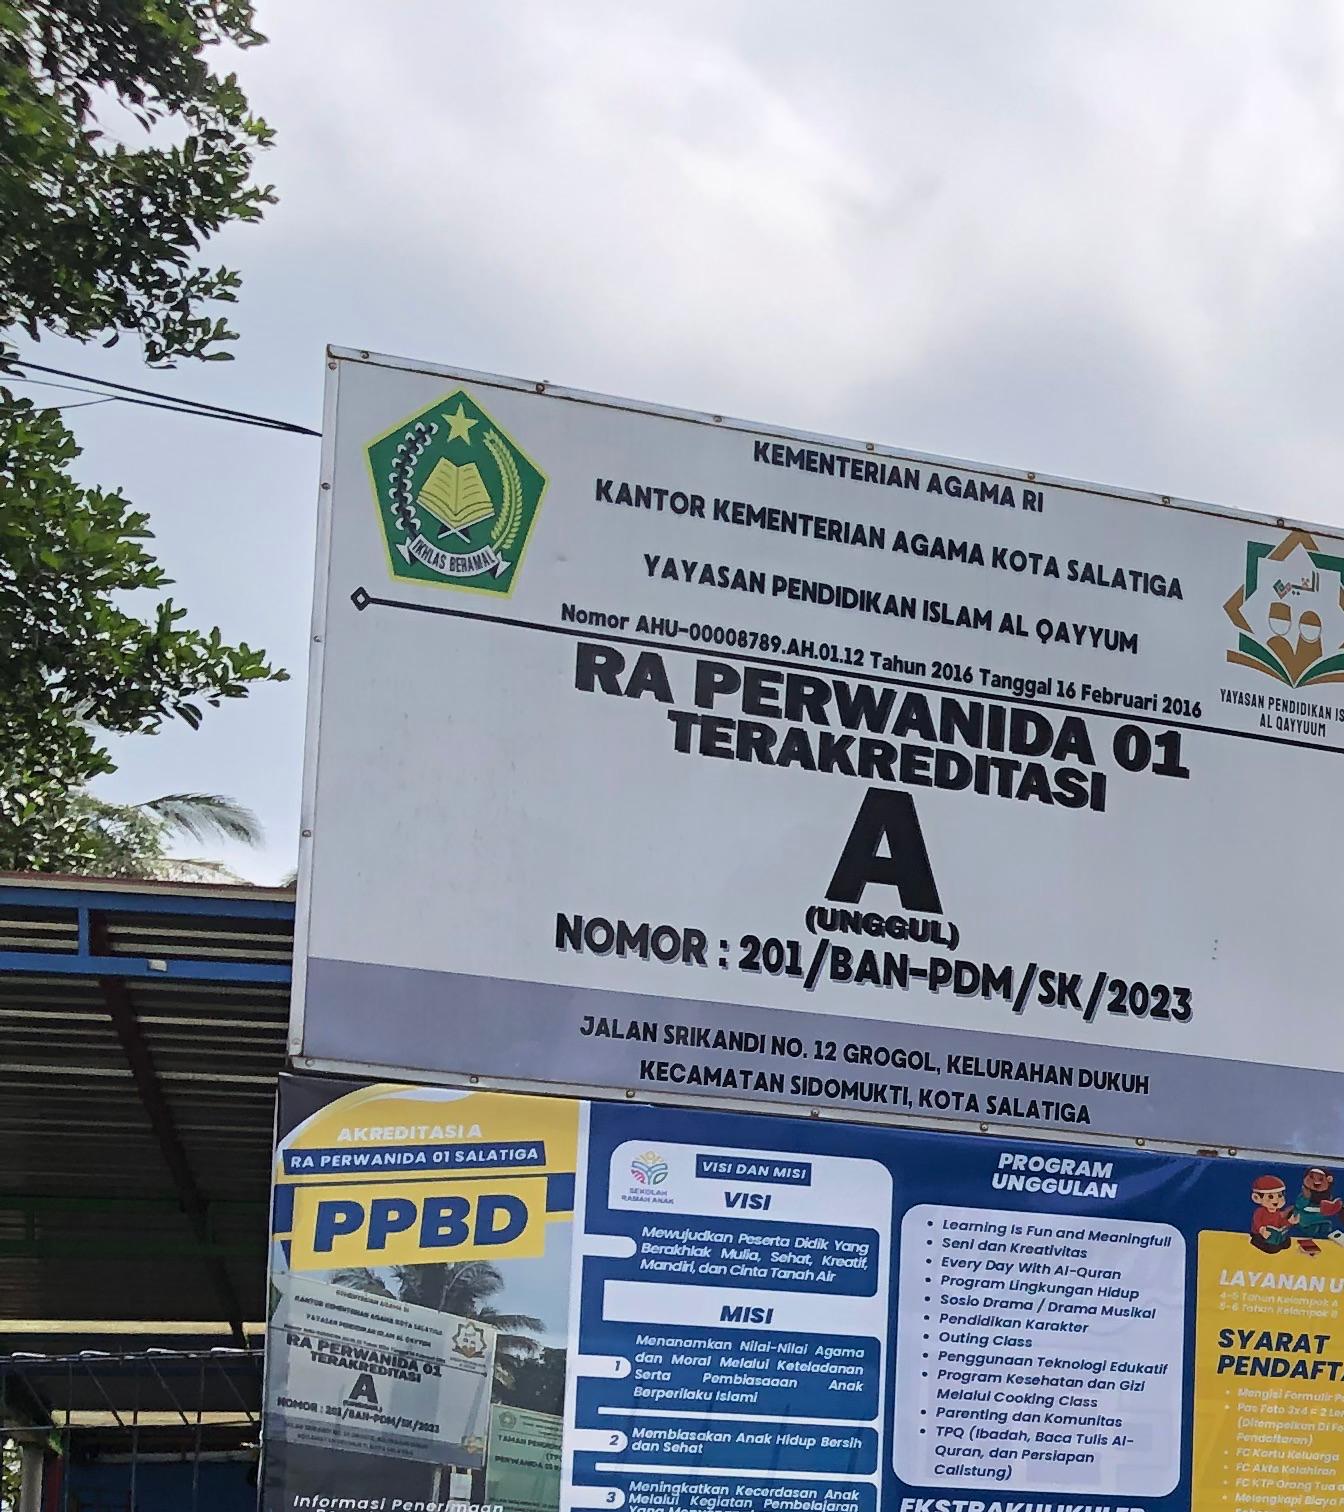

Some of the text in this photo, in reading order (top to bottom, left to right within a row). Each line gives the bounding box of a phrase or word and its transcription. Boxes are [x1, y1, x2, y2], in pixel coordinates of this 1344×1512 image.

[753, 440, 1043, 512] KEMENTERIAN AGAMA RI
[595, 478, 1183, 600] KANTOR KEMENTERIAN AGAMA KOTA SALATIGA
[412, 540, 495, 572] IKHLAS BERAMAL
[643, 553, 1138, 654] YAYASAN PENDIDIKAN ISLAM AL QAYYUM
[561, 603, 1201, 718] Nomor AHU-00008789.AH.01.12 Tahun 2016 Tanggal 16 Februari 2016
[574, 642, 1189, 779] RA PERWANIDA 01
[1220, 688, 1264, 708] YAYASAN
[1268, 696, 1331, 720] PENDIDIKAN
[1259, 713, 1325, 737] AL QAYYUUM
[667, 709, 1106, 812] TERAKREDITASI
[824, 786, 944, 915] A
[805, 905, 959, 951] (UNGGUL)
[555, 912, 708, 967] NOMOR
[738, 934, 1193, 1023] 201/BAN-PDM/SK/2023
[579, 1015, 1149, 1094] JALAN SRIKANDI NO. 12 GROGOL, KELURAHAN DUKUH
[639, 1061, 1090, 1124] KECAMATAN SIDOMUKTI, KOTA SALATIGA
[336, 1123, 483, 1143] AKREDITASI A
[290, 1147, 538, 1168] RA PERWANIDA 01 SALATIGA
[702, 1161, 806, 1179] VISI DAN MISI
[995, 1152, 1113, 1179] PROGRAM
[724, 1191, 771, 1210] VISI
[991, 1172, 1118, 1198] UNGGULAN
[312, 1193, 529, 1252] PPBD
[642, 1226, 869, 1256] Mewujudkan Peserta Didik Yang
[1219, 1269, 1323, 1292] LAYANAN
[719, 1305, 774, 1324] MISI
[938, 1331, 1032, 1348] Outing Class
[1218, 1328, 1330, 1355] SYARAT
[293, 1495, 387, 1510] Informasi
